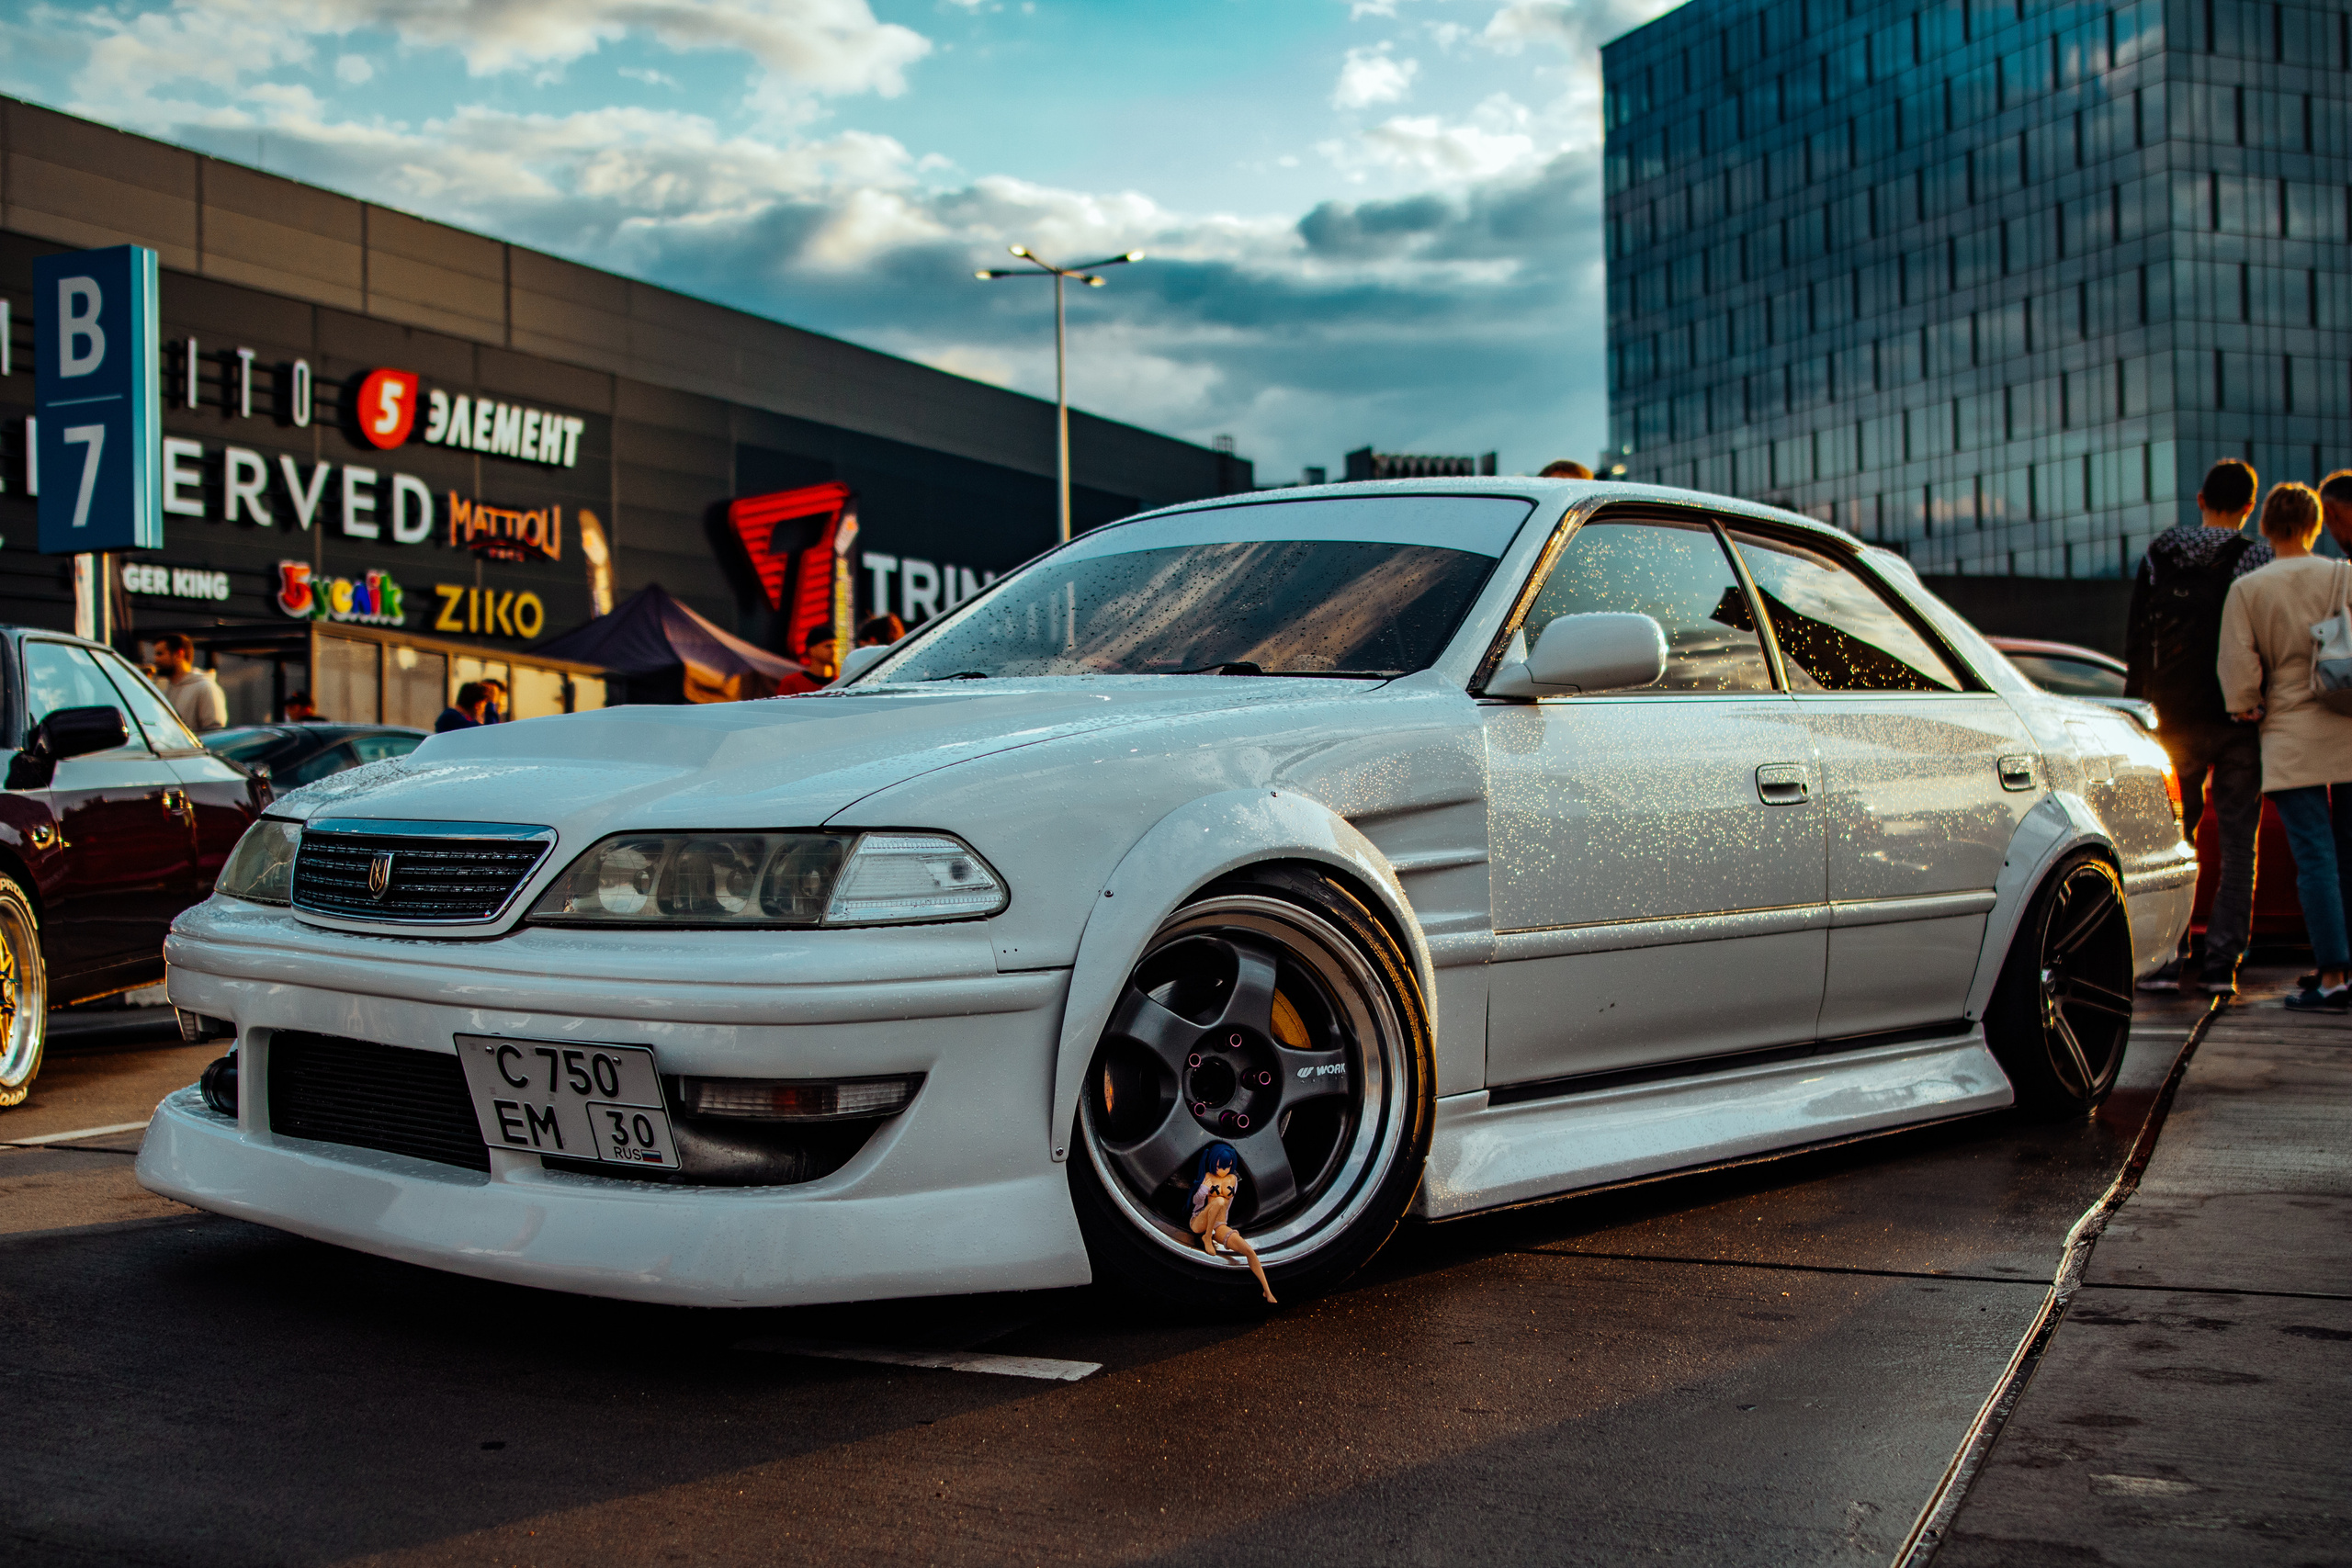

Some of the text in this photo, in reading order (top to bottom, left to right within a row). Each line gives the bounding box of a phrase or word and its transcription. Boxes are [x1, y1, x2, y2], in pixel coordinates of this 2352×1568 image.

[58, 276, 107, 378] B
[374, 379, 585, 468] 5 ЭЛЕМЕНТ
[63, 424, 105, 527] 7
[163, 436, 434, 544] ERVED
[122, 562, 230, 601] GER KING
[435, 584, 545, 638] ZIKO
[496, 1043, 620, 1098] C 750
[1316, 1063, 1346, 1076] WORK
[493, 1100, 655, 1149] EM 30
[614, 1146, 642, 1160] RUS
